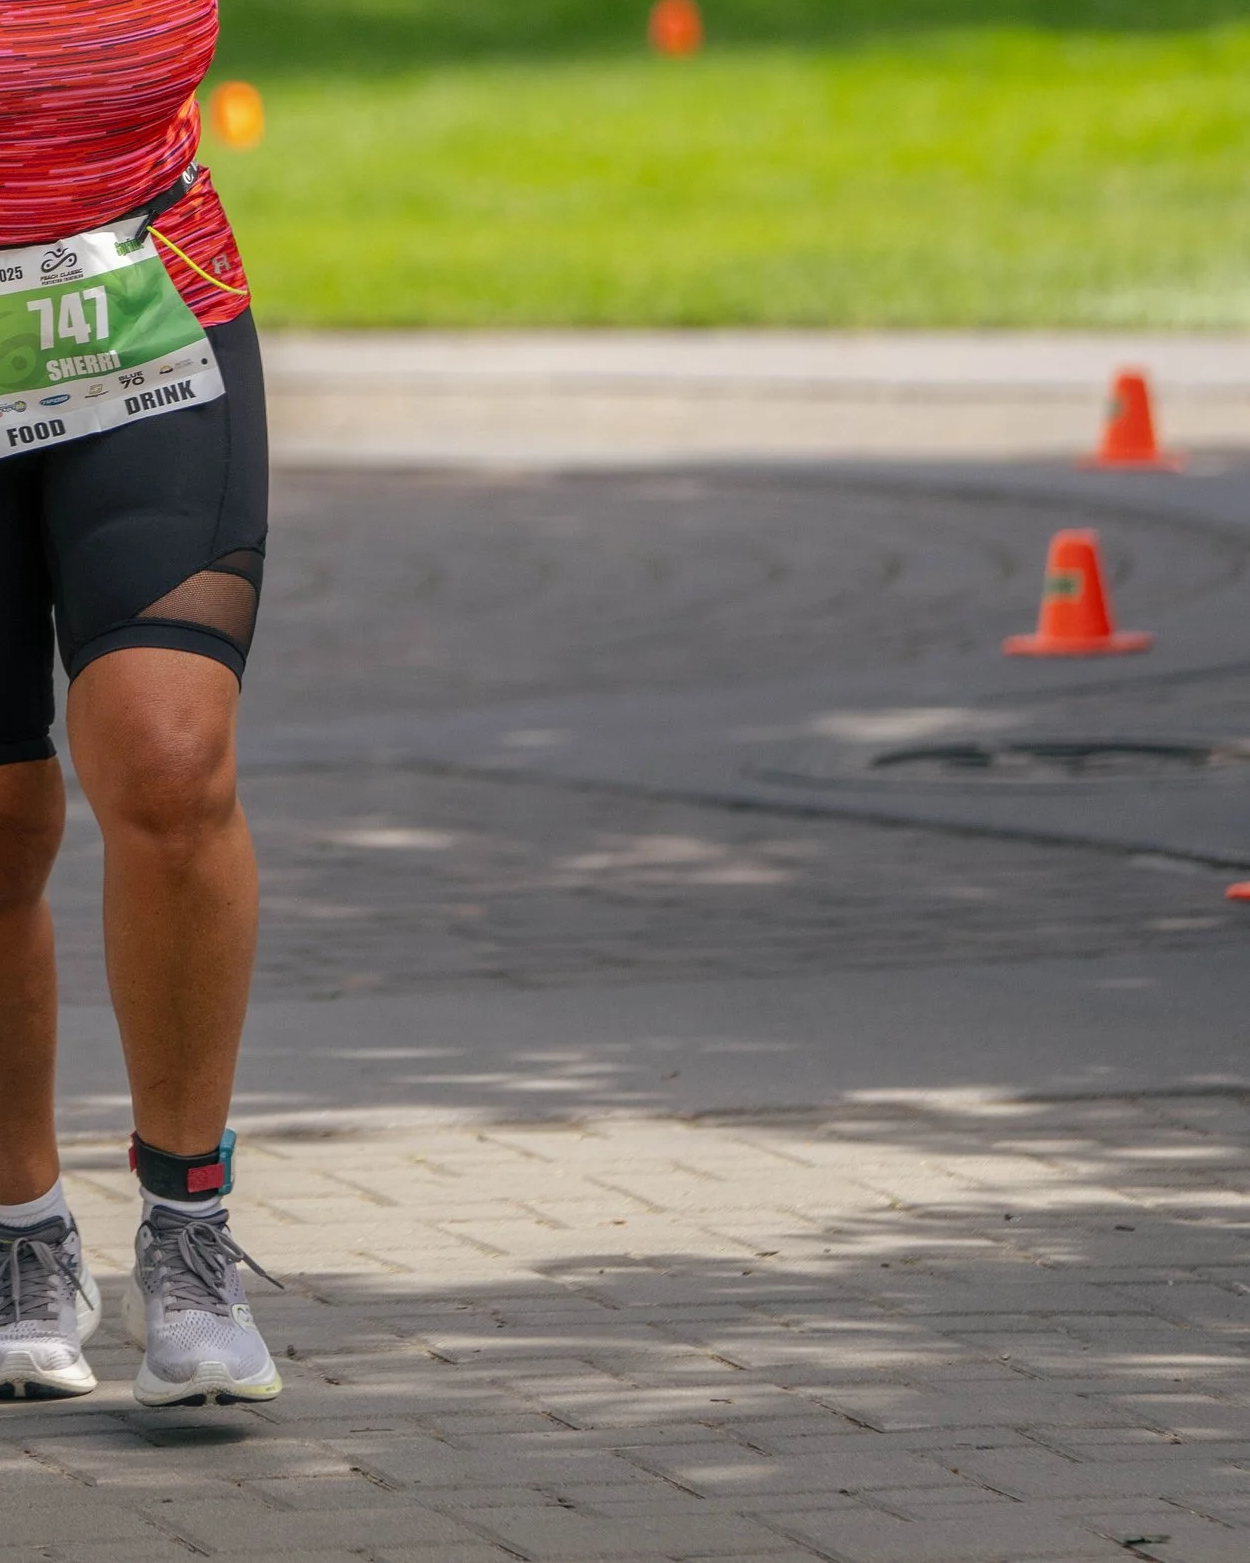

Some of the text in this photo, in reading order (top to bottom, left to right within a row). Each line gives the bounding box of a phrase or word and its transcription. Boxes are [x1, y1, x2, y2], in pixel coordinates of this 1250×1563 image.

[60, 268, 83, 278] CLASSIC
[26, 285, 110, 351] 747
[46, 349, 121, 381] SHERRI
[118, 370, 144, 381] BLUE
[120, 377, 145, 390] 70
[6, 379, 197, 447] FOOD DRINK
